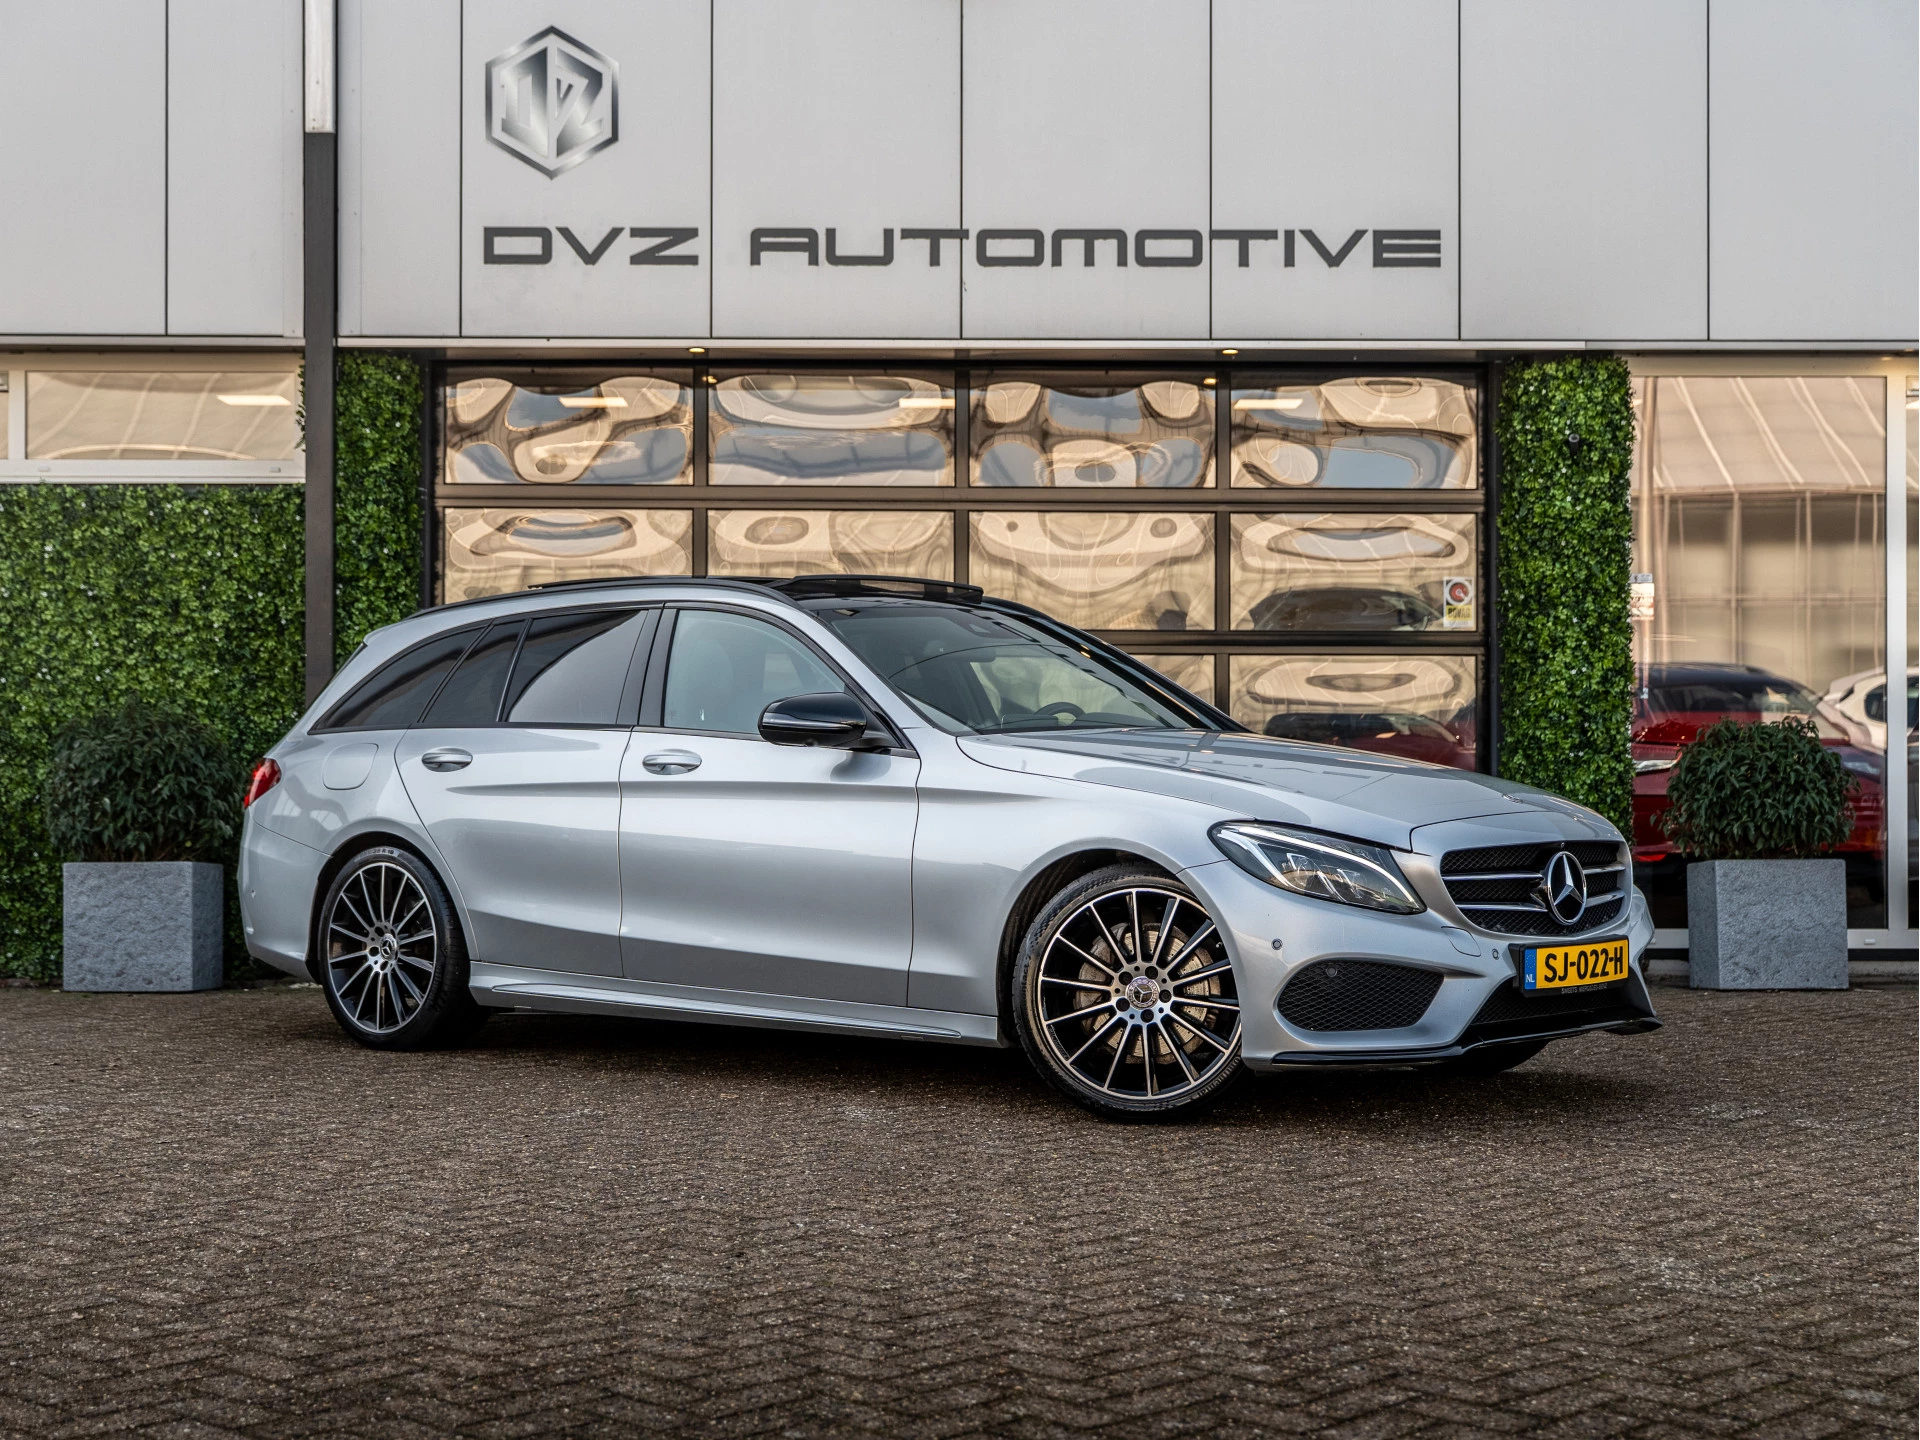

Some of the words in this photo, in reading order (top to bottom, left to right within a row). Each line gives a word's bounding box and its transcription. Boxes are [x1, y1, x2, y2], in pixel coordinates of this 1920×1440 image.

[483, 226, 699, 266] DVZ
[749, 227, 1442, 269] AUTOMOTIVE
[1525, 973, 1535, 983] NL
[1543, 945, 1624, 983] SJ-022-H
